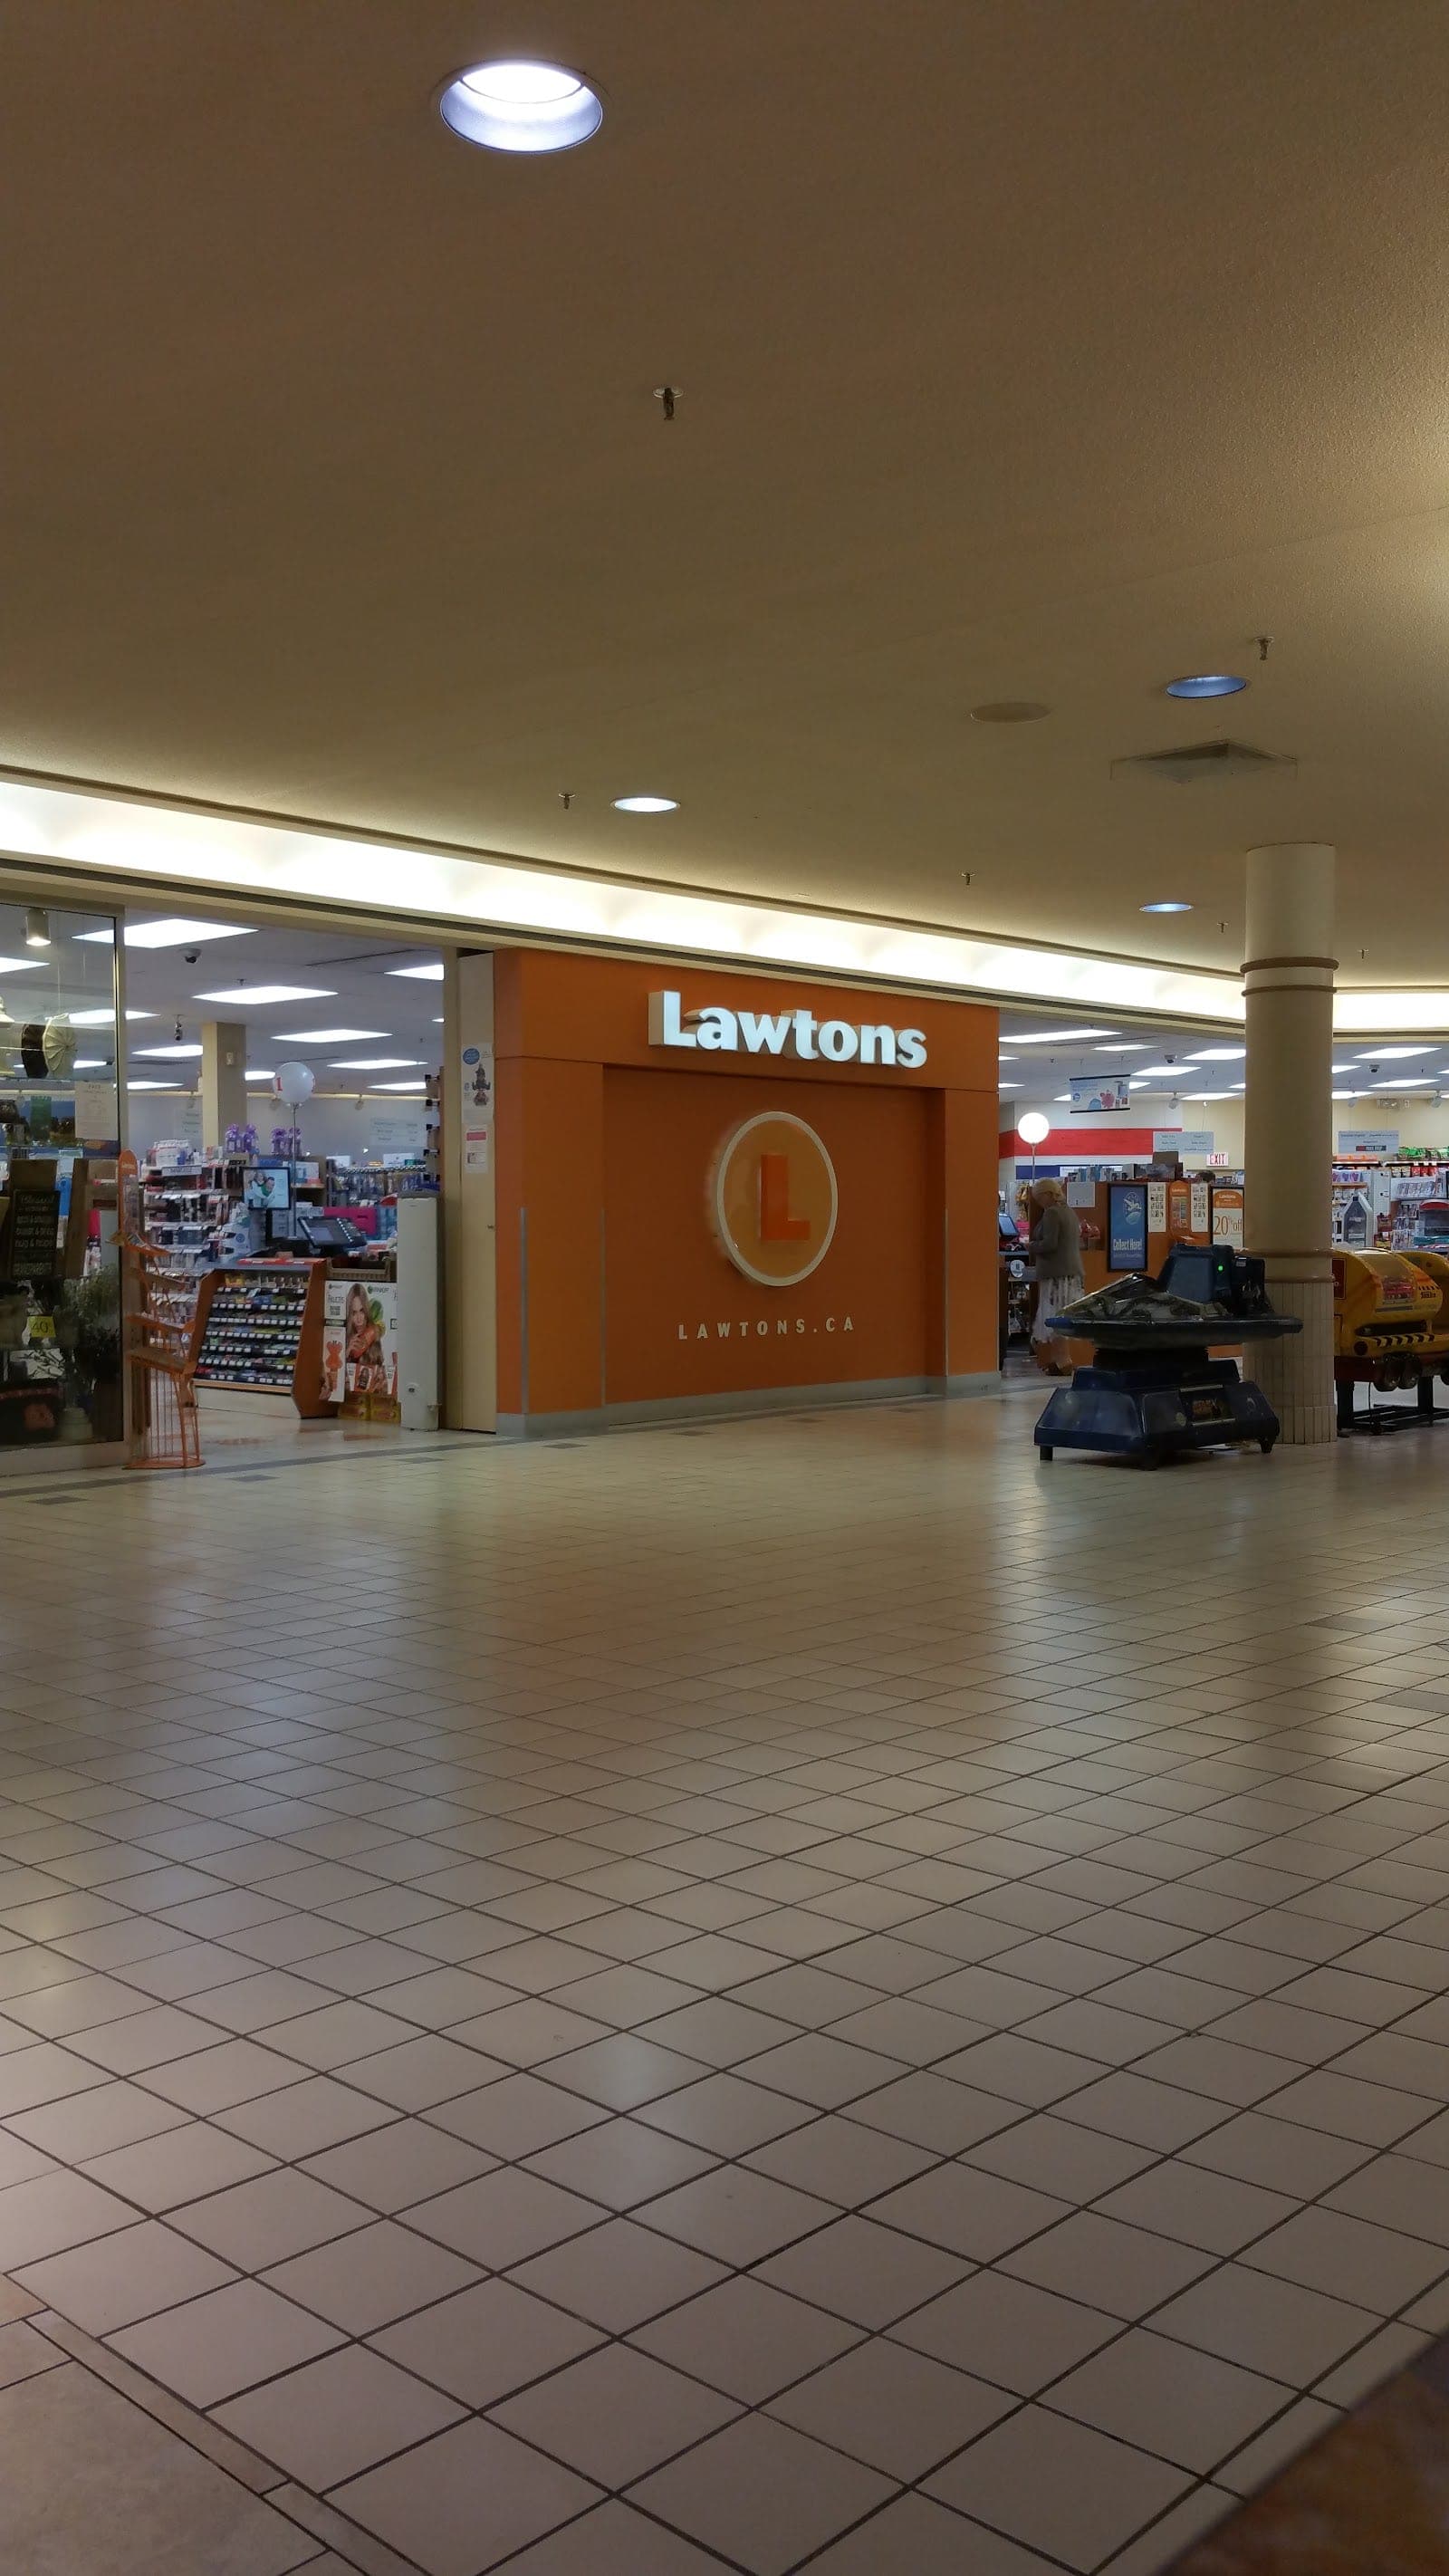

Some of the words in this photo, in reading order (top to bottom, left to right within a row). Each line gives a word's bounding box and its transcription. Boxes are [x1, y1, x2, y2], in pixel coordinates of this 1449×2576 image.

[648, 990, 928, 1069] Lawtons
[1209, 1153, 1226, 1165] EXIT
[759, 1153, 811, 1241] L
[1113, 1238, 1129, 1251] Collect
[678, 1316, 854, 1341] LAWTONS.CA
